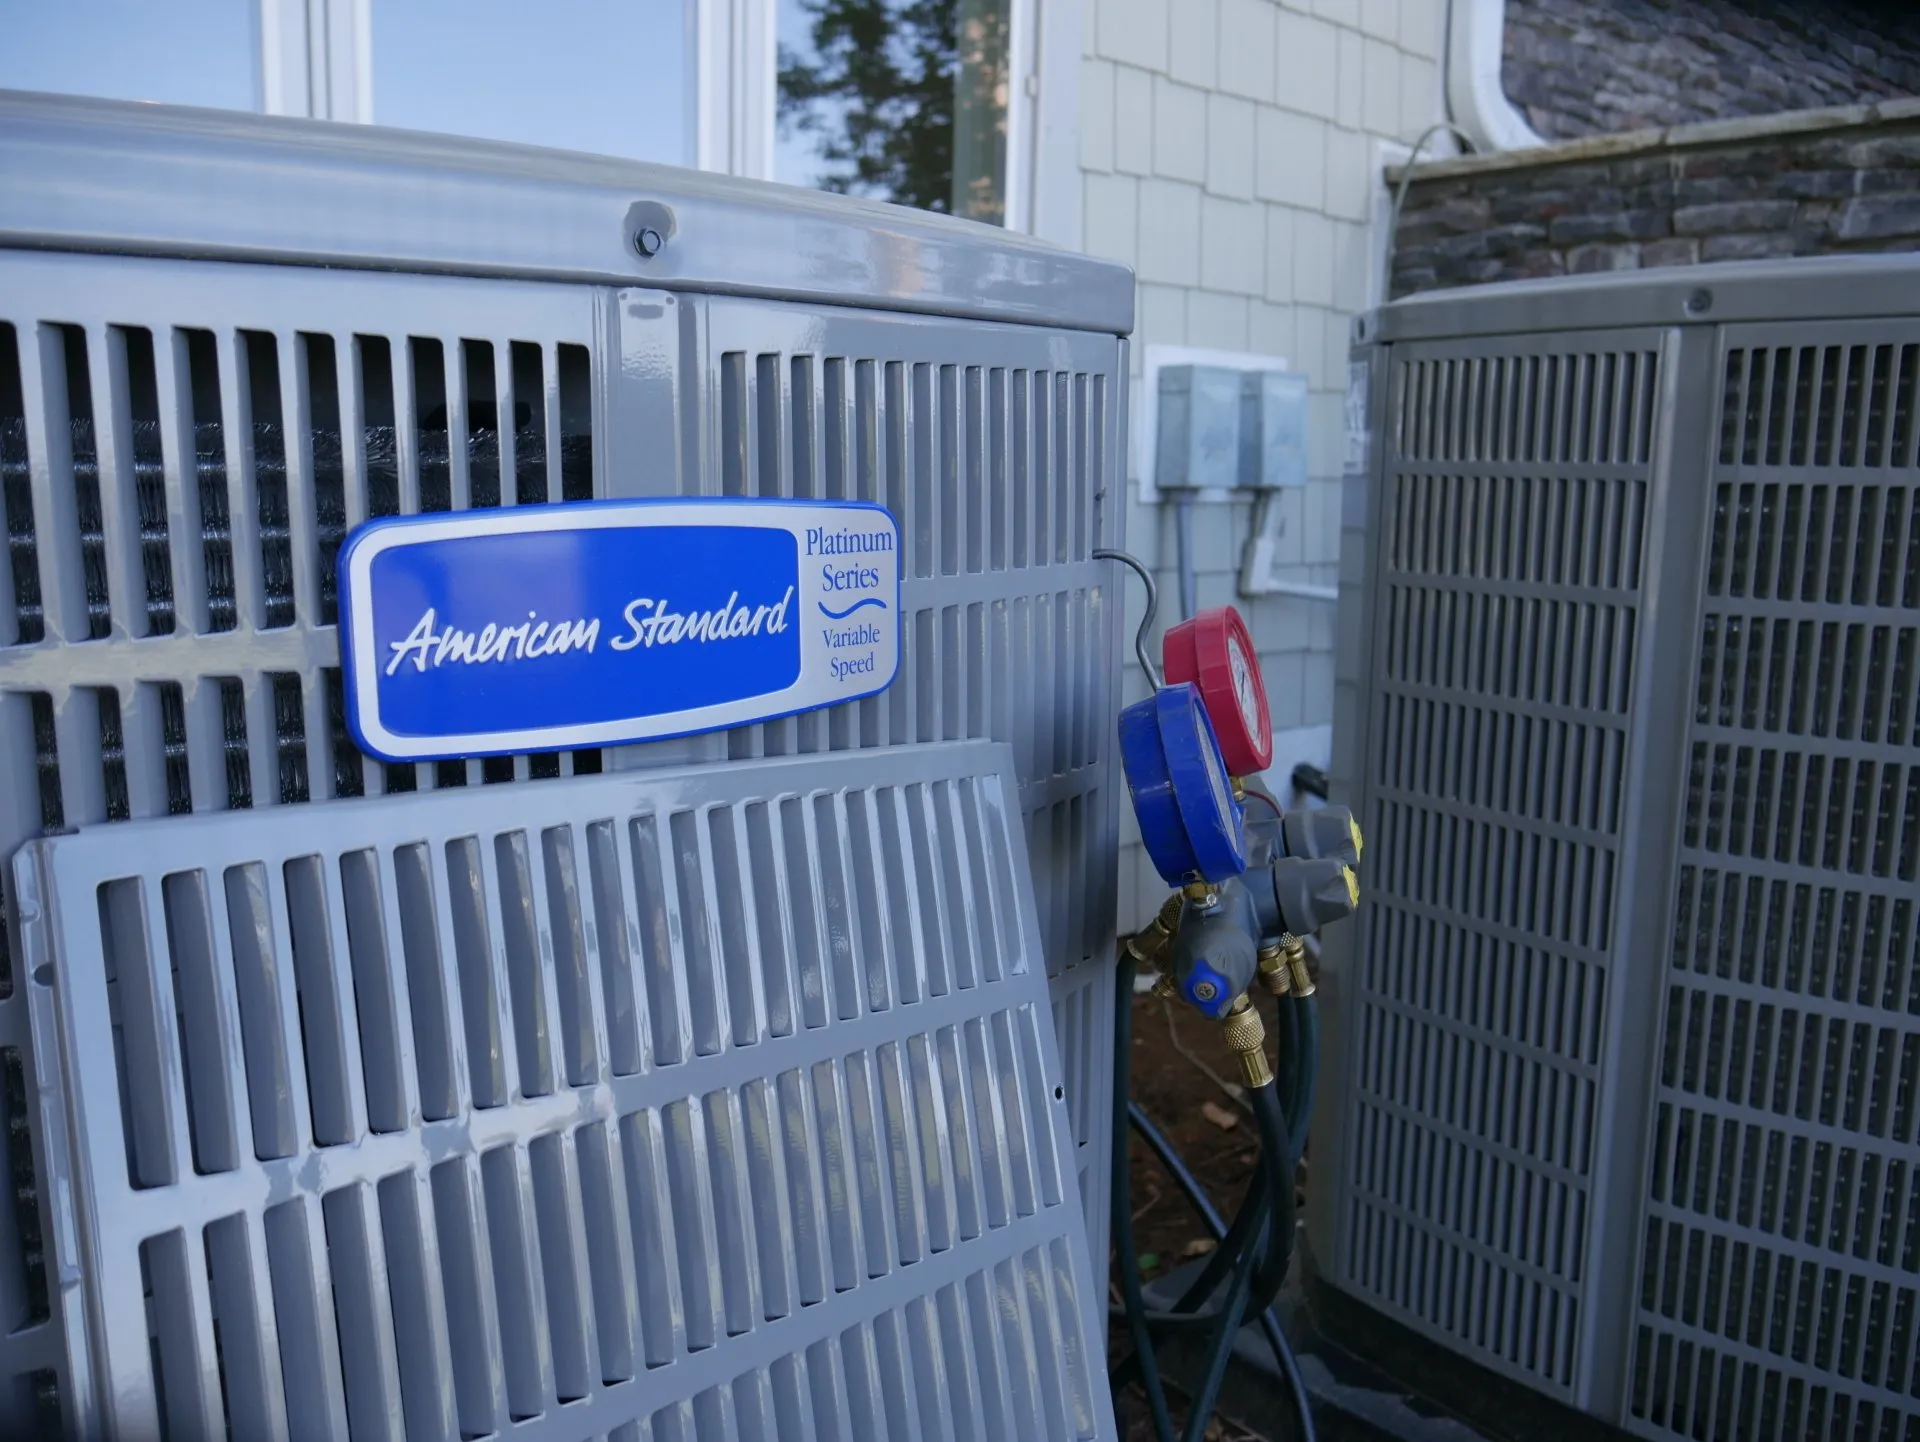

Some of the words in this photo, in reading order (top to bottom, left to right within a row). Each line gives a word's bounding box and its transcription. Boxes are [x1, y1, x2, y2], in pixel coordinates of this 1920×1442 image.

[805, 526, 893, 556] Platinum
[822, 563, 879, 592] Series
[386, 607, 600, 676] American
[611, 585, 794, 651] Standard
[822, 623, 880, 649] Variable
[830, 651, 875, 682] Speed
